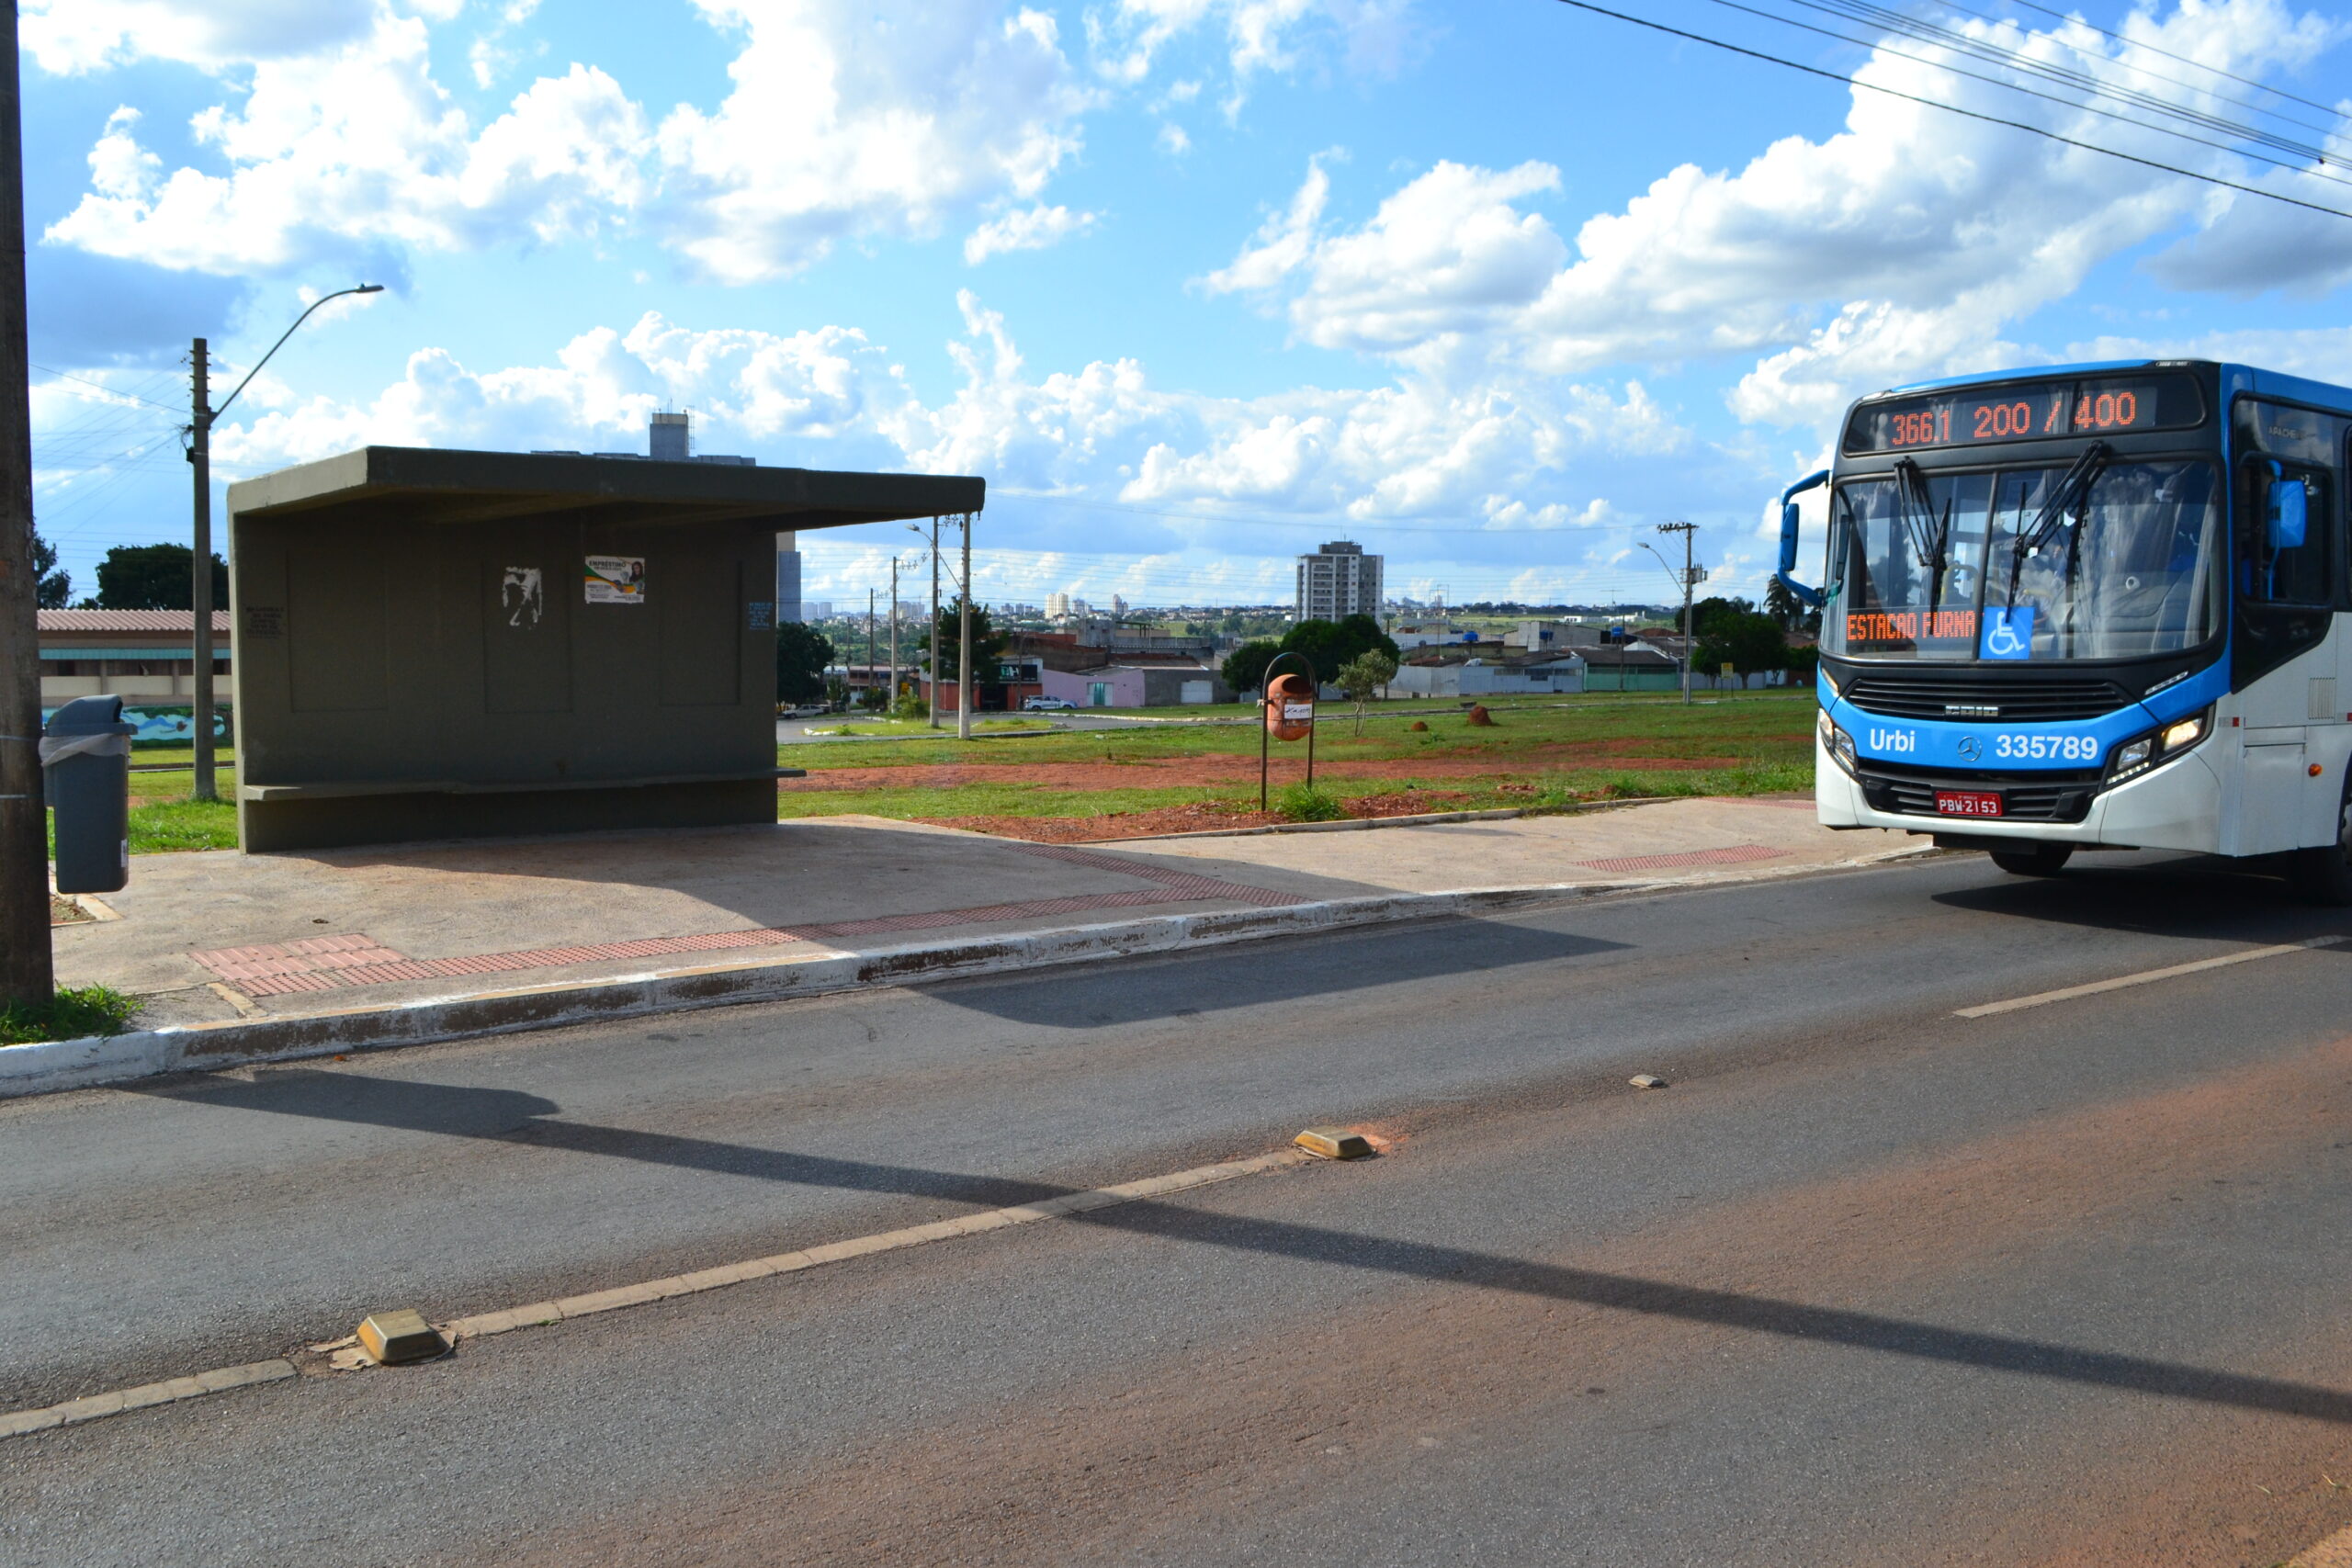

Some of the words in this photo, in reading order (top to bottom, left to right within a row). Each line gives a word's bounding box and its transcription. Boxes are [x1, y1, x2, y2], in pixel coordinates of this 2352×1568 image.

[1892, 410, 1950, 446] 366.1
[1973, 401, 2030, 438] 200
[2043, 400, 2061, 432] /
[2074, 391, 2136, 429] 400
[1847, 613, 1917, 640] ESTACAO
[1922, 610, 1984, 638] FURNA
[1870, 728, 1915, 752] Urbi
[1996, 734, 2098, 761] 335789
